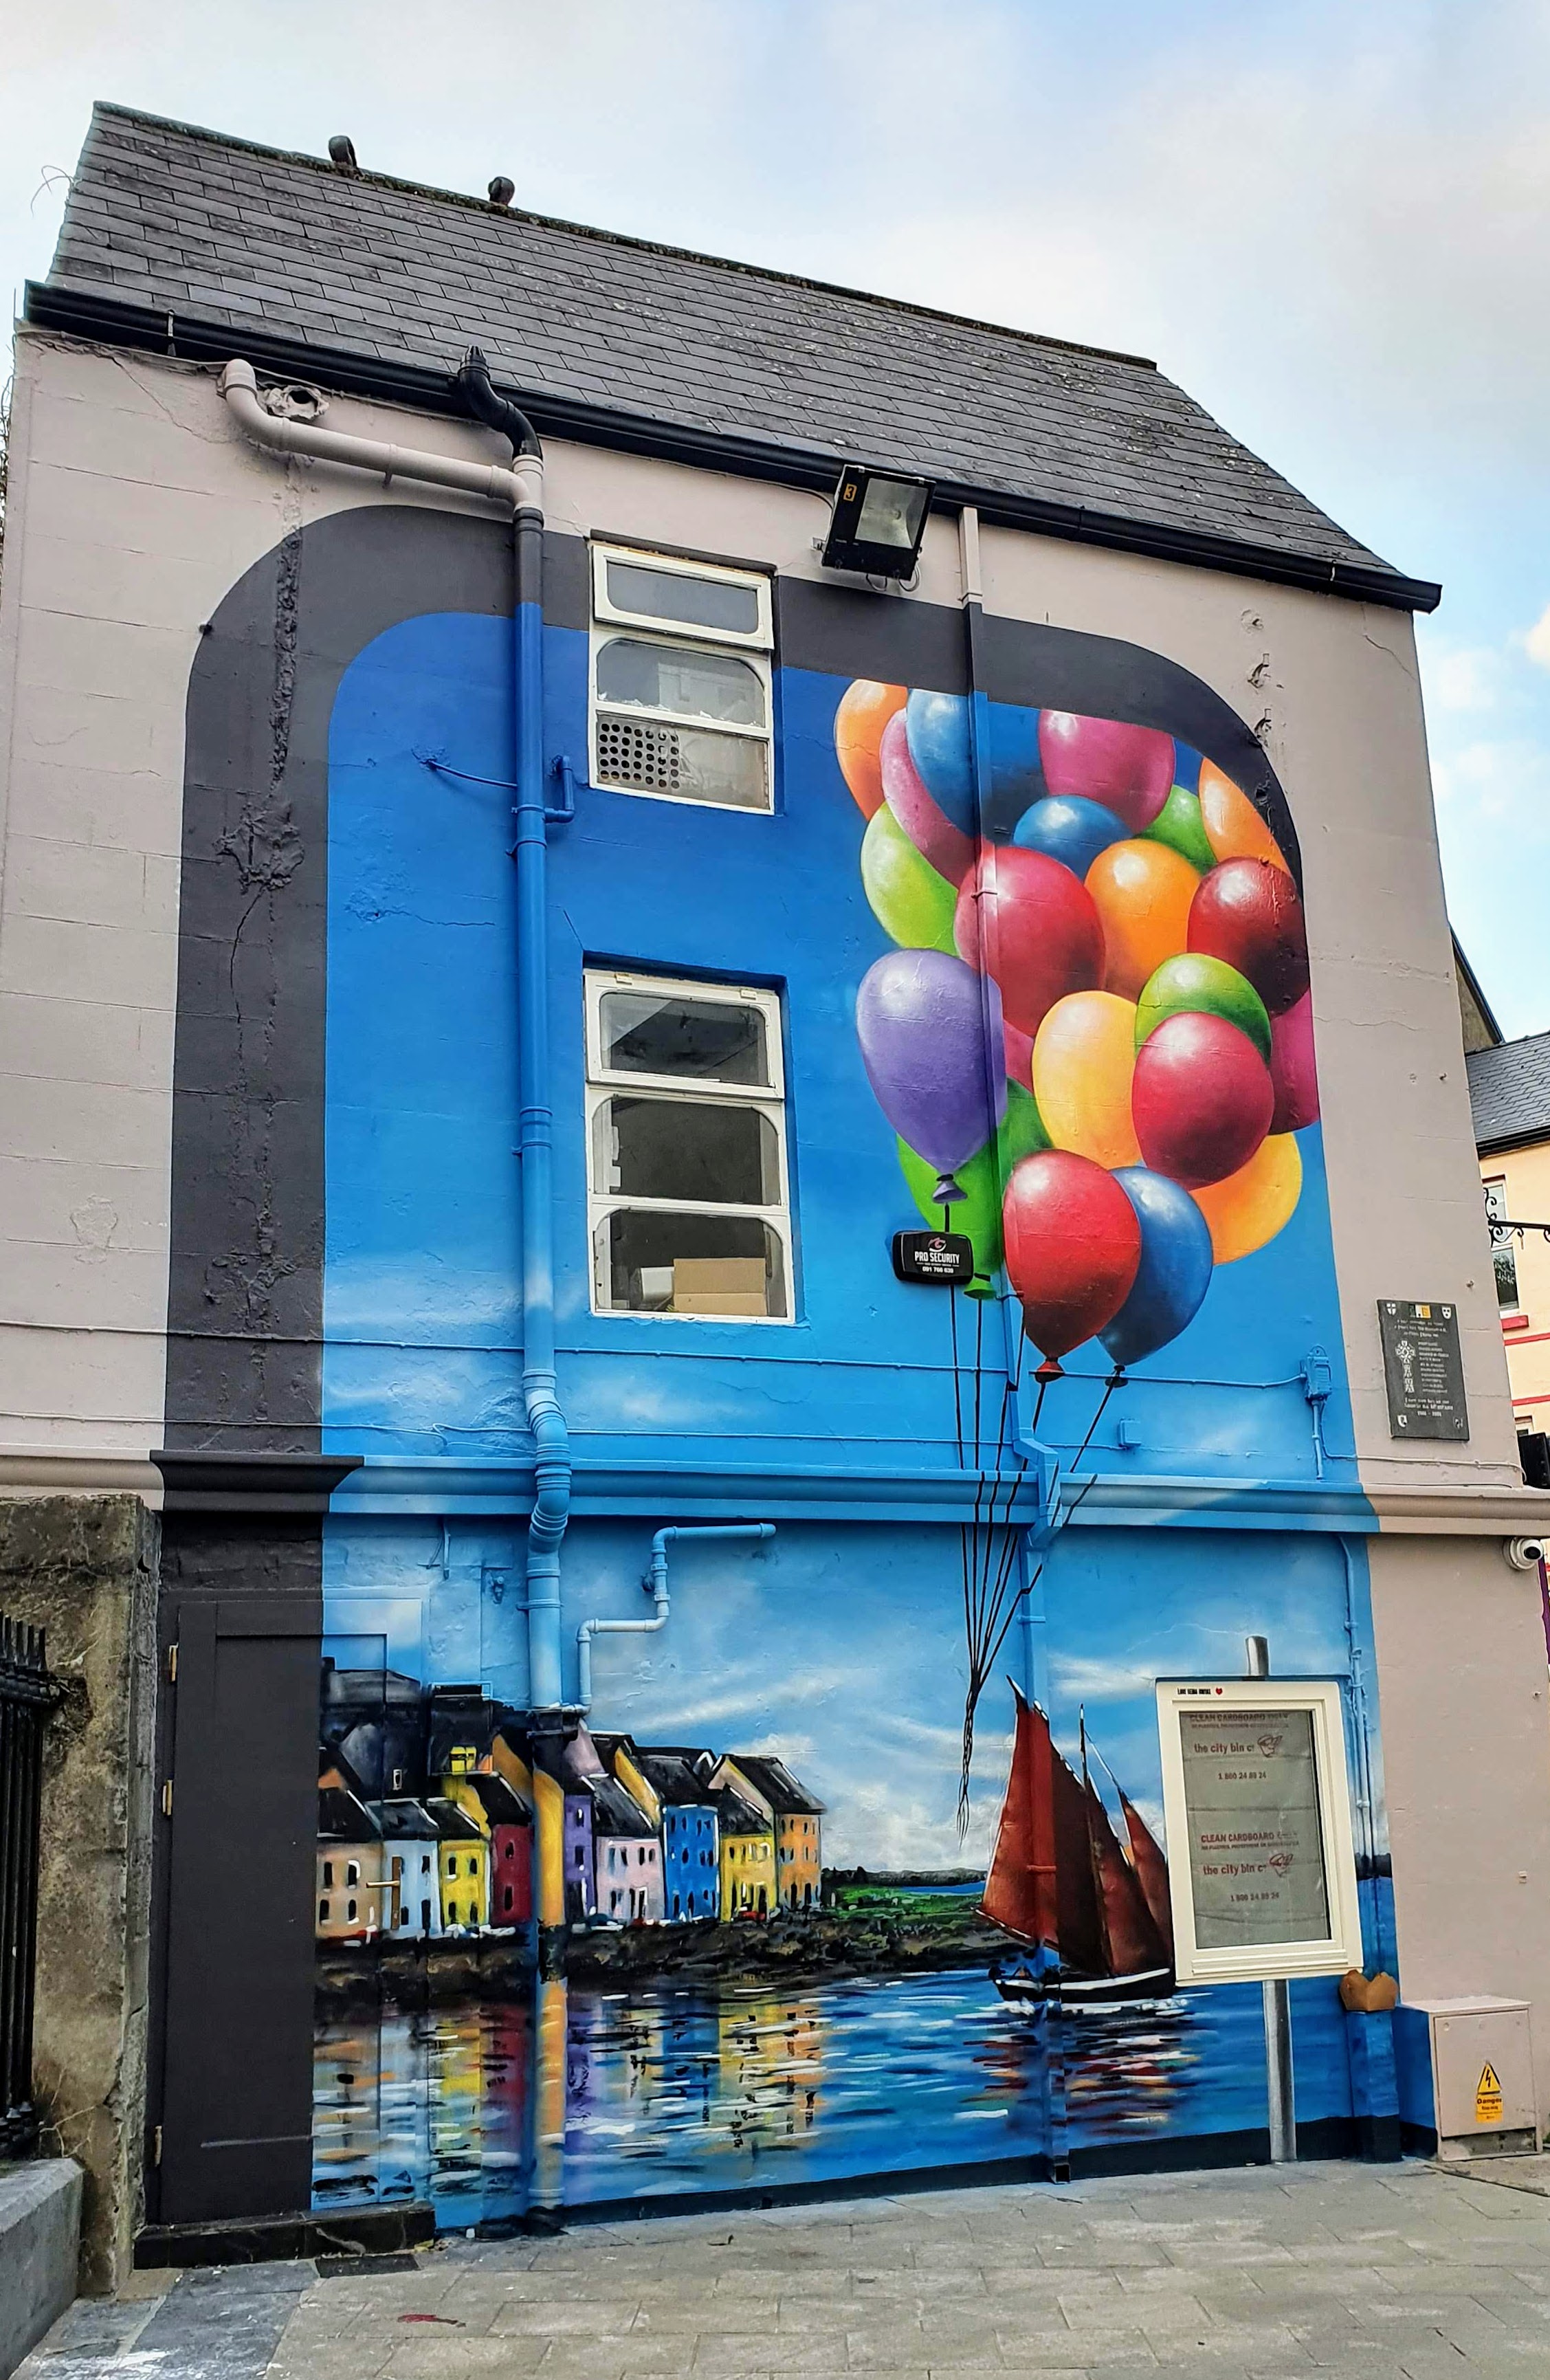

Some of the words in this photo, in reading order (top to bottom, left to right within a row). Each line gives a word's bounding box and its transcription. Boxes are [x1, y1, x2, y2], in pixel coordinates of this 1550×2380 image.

[845, 485, 854, 500] 3
[914, 1251, 929, 1262] PRO
[929, 1252, 960, 1264] SECURITY
[1194, 1743, 1208, 1753] the
[1210, 1743, 1228, 1754] city
[1230, 1742, 1245, 1752] bin
[1201, 1834, 1226, 1843] CLEAN
[1228, 1832, 1274, 1842] CARDBOARD
[1203, 1865, 1218, 1875] the
[1221, 1864, 1239, 1876] city
[1241, 1864, 1255, 1874] bin
